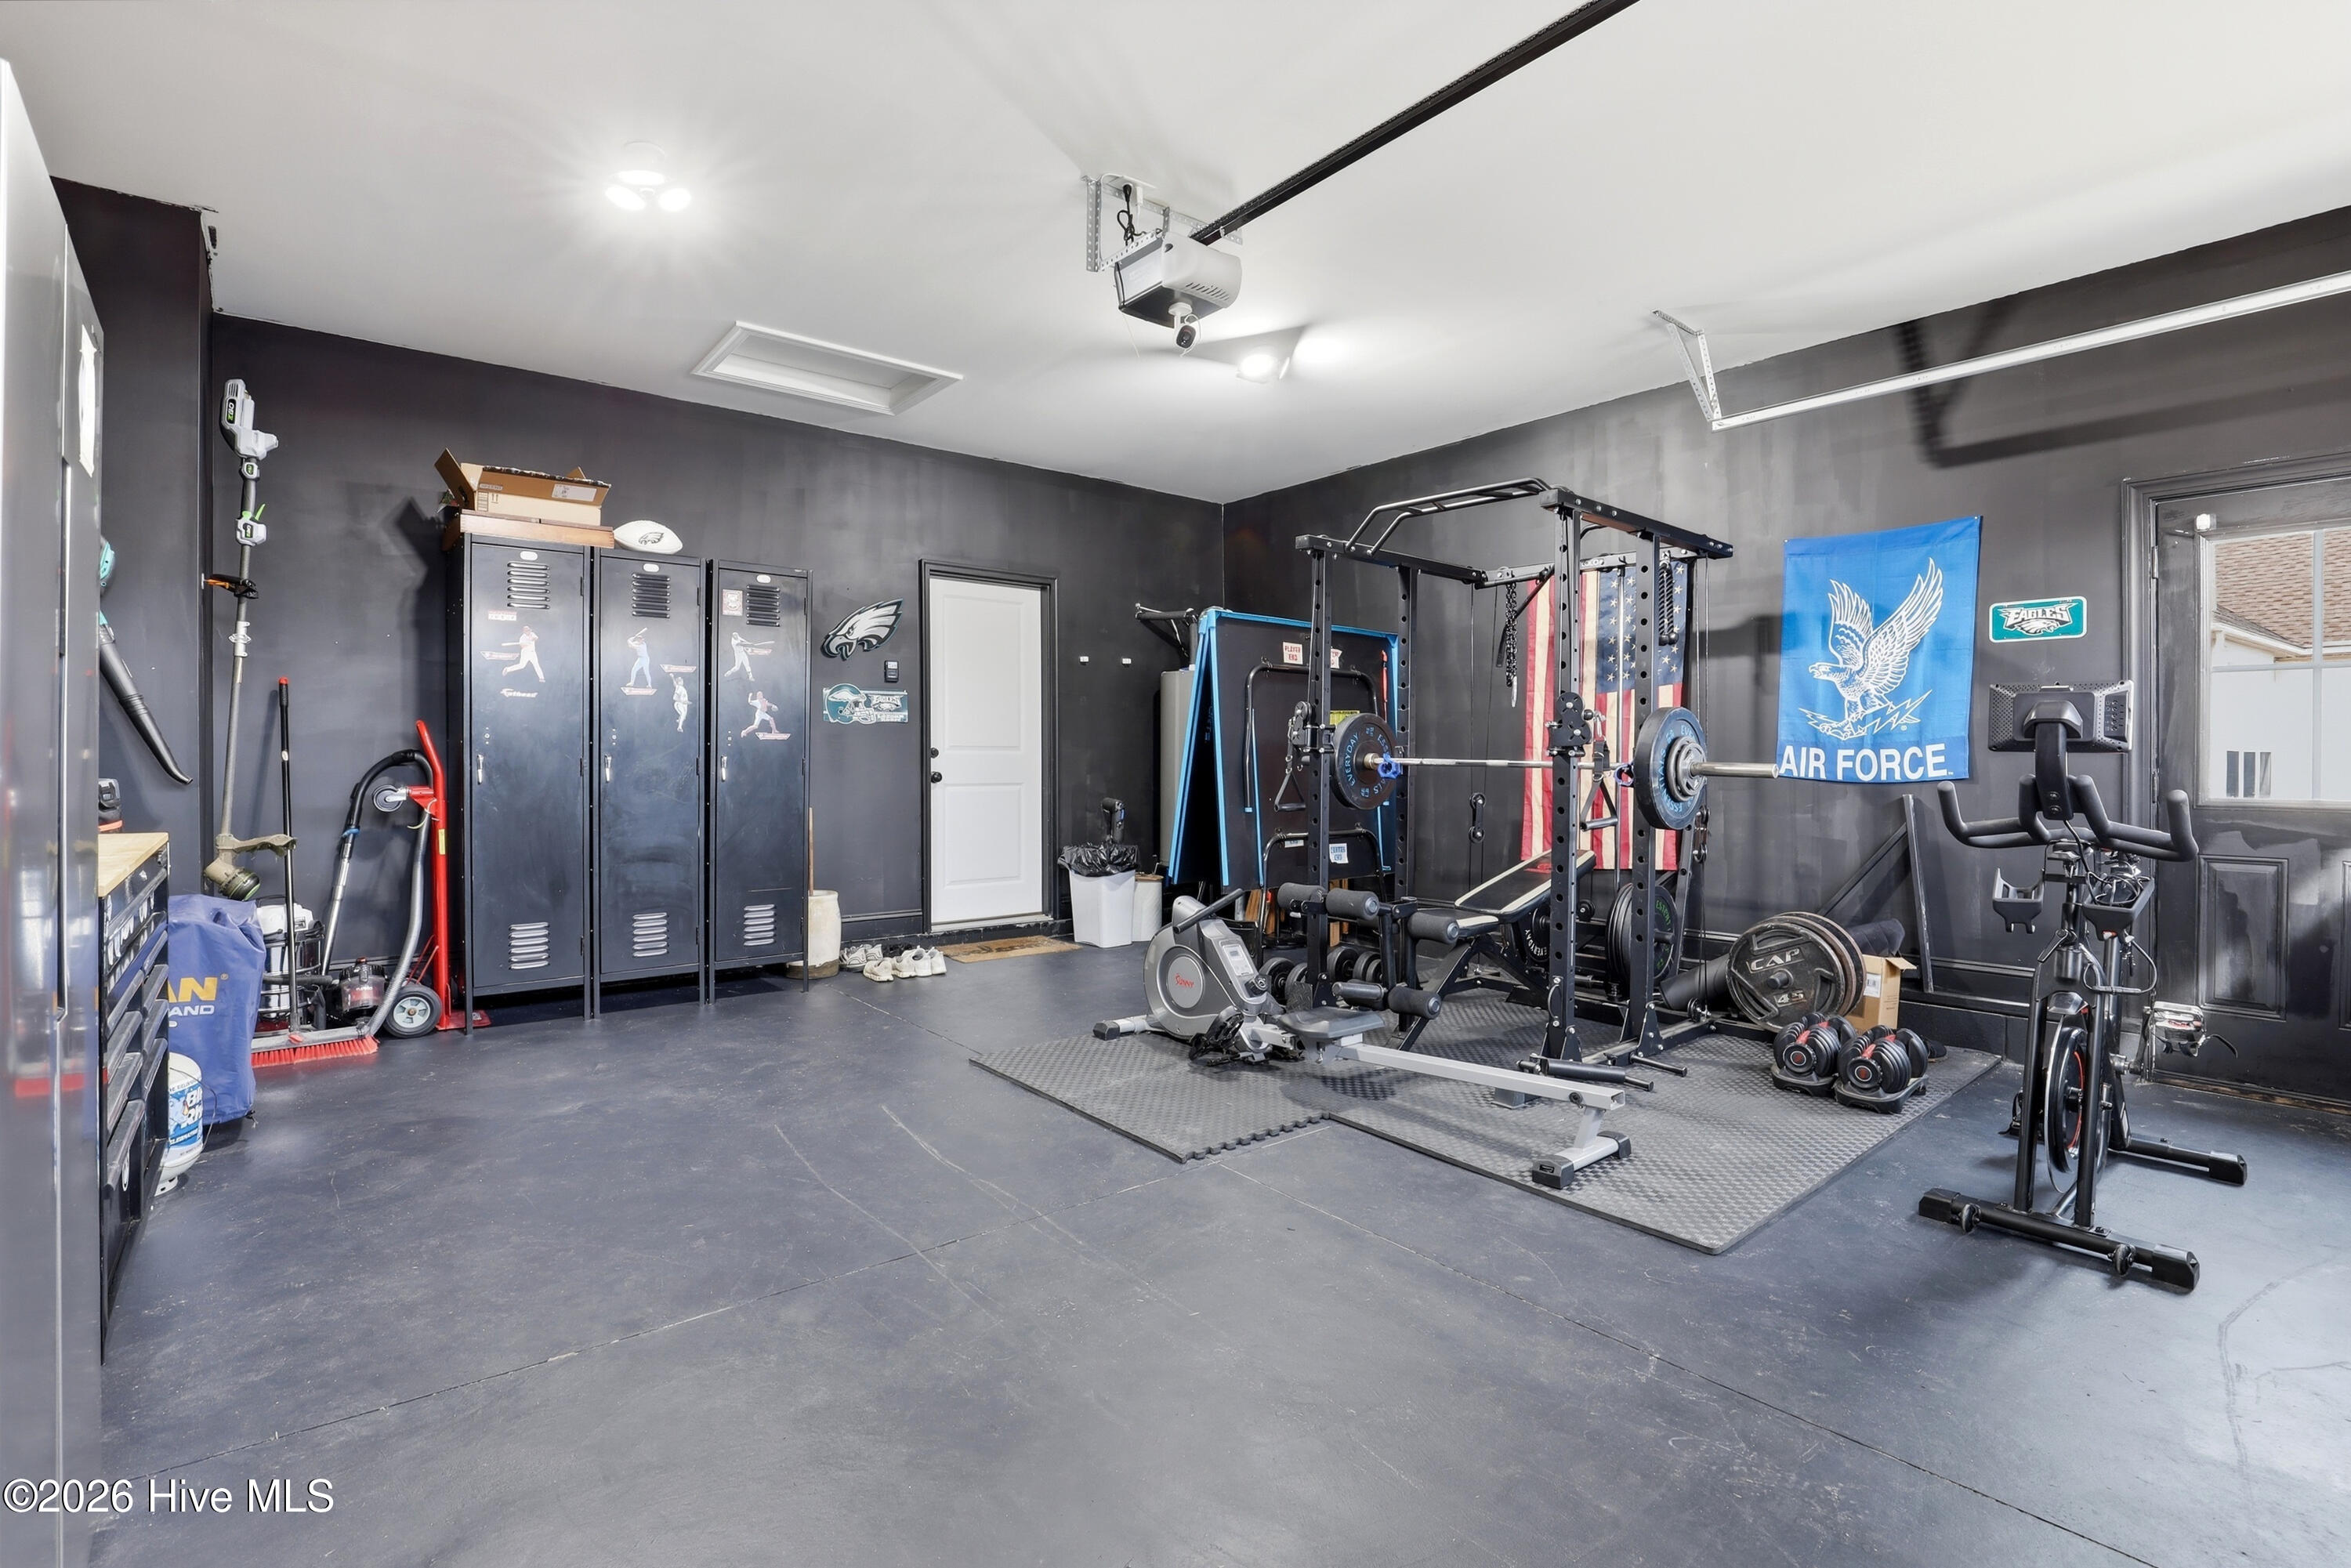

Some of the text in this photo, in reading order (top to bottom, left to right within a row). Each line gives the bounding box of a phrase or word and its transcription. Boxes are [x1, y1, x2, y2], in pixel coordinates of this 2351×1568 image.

[1998, 602, 2078, 628] EAGLES
[1344, 732, 1359, 787] EVERYDAY
[1779, 743, 1948, 782] AIR FORCE
[1750, 948, 1800, 971] CAP
[1175, 973, 1195, 988] SUNNY
